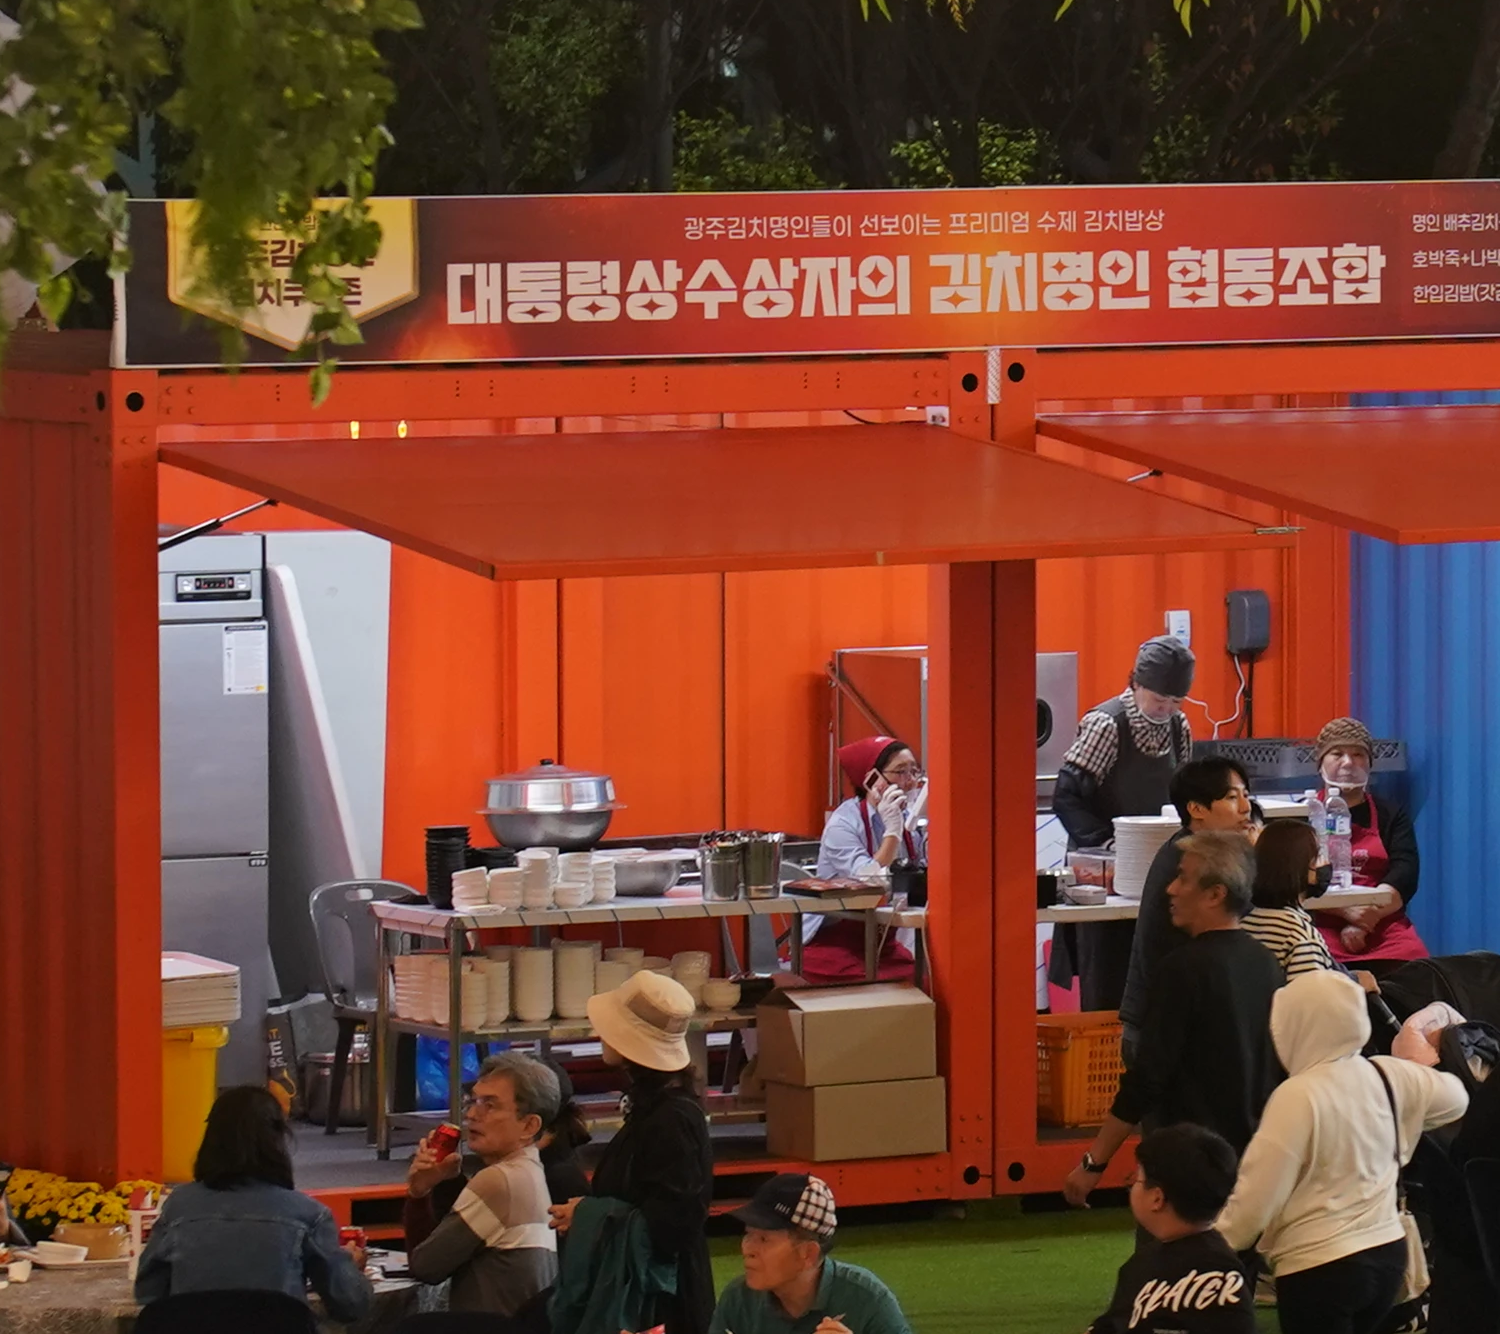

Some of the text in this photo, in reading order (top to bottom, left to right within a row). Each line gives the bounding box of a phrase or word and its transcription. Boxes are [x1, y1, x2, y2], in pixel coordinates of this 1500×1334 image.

[683, 209, 1165, 240] 광주김치명인들이 선보이는 프리미엄 수제 김치밥상
[1413, 213, 1441, 232] 명인
[446, 243, 1386, 324] 대통령상수상자의 김치명인 협동조합
[1129, 1269, 1244, 1329] SKATER
